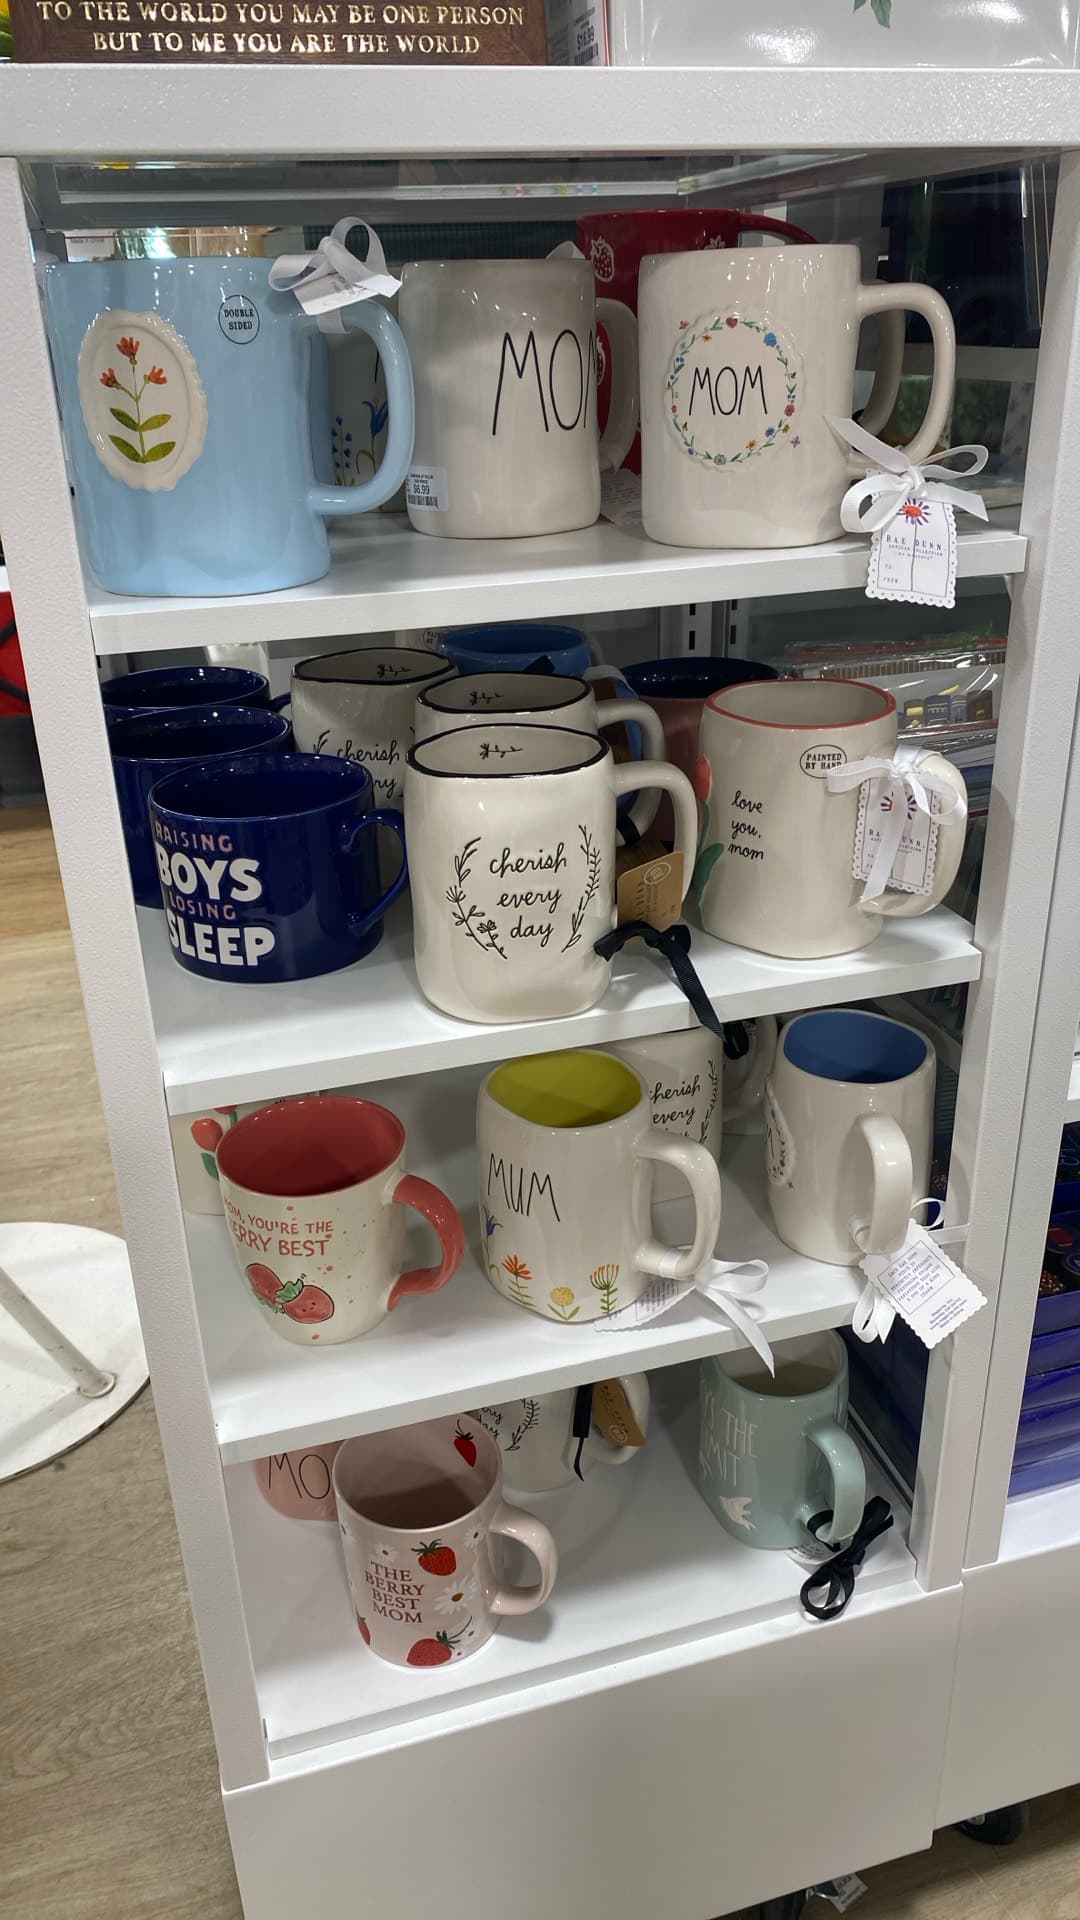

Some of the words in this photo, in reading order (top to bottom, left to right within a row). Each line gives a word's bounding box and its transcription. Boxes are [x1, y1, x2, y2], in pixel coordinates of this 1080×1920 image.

[37, 1, 72, 20] TO
[80, 2, 130, 21] THE
[139, 2, 227, 23] WORLD
[236, 3, 284, 23] YOU
[292, 4, 340, 24] MAY
[348, 5, 376, 24] BE
[383, 5, 430, 25] ONE
[436, 6, 524, 25] PERSON
[93, 31, 141, 51] BUT
[149, 32, 183, 52] TO
[191, 32, 226, 53] ME
[233, 32, 281, 53] YOU
[290, 34, 336, 54] ARE
[342, 34, 389, 53] THE
[396, 34, 480, 54] WORLD
[224, 308, 254, 318] DOUBLE
[229, 320, 253, 331] SIDED
[689, 365, 768, 416] MOM
[805, 762, 816, 770] BY
[806, 753, 842, 761] PAINTED
[731, 790, 763, 814] love
[155, 820, 233, 853] RAISING
[489, 842, 567, 878] cherish
[728, 843, 764, 860] mom
[155, 841, 262, 902] BOYS
[169, 890, 237, 921] LOSING
[496, 888, 562, 914] every
[166, 907, 276, 966] SLEEP
[510, 915, 554, 947] day
[649, 1074, 701, 1104] herish
[653, 1106, 696, 1125] every
[487, 1151, 561, 1223] MUM
[247, 1212, 300, 1235] YOU'RE
[305, 1220, 334, 1234] THE
[278, 1239, 330, 1257] BEST
[721, 1408, 760, 1458] THE
[370, 1560, 413, 1582] THE
[365, 1571, 425, 1596] BERRY
[372, 1587, 420, 1610] BEST
[373, 1601, 423, 1624] MOM
